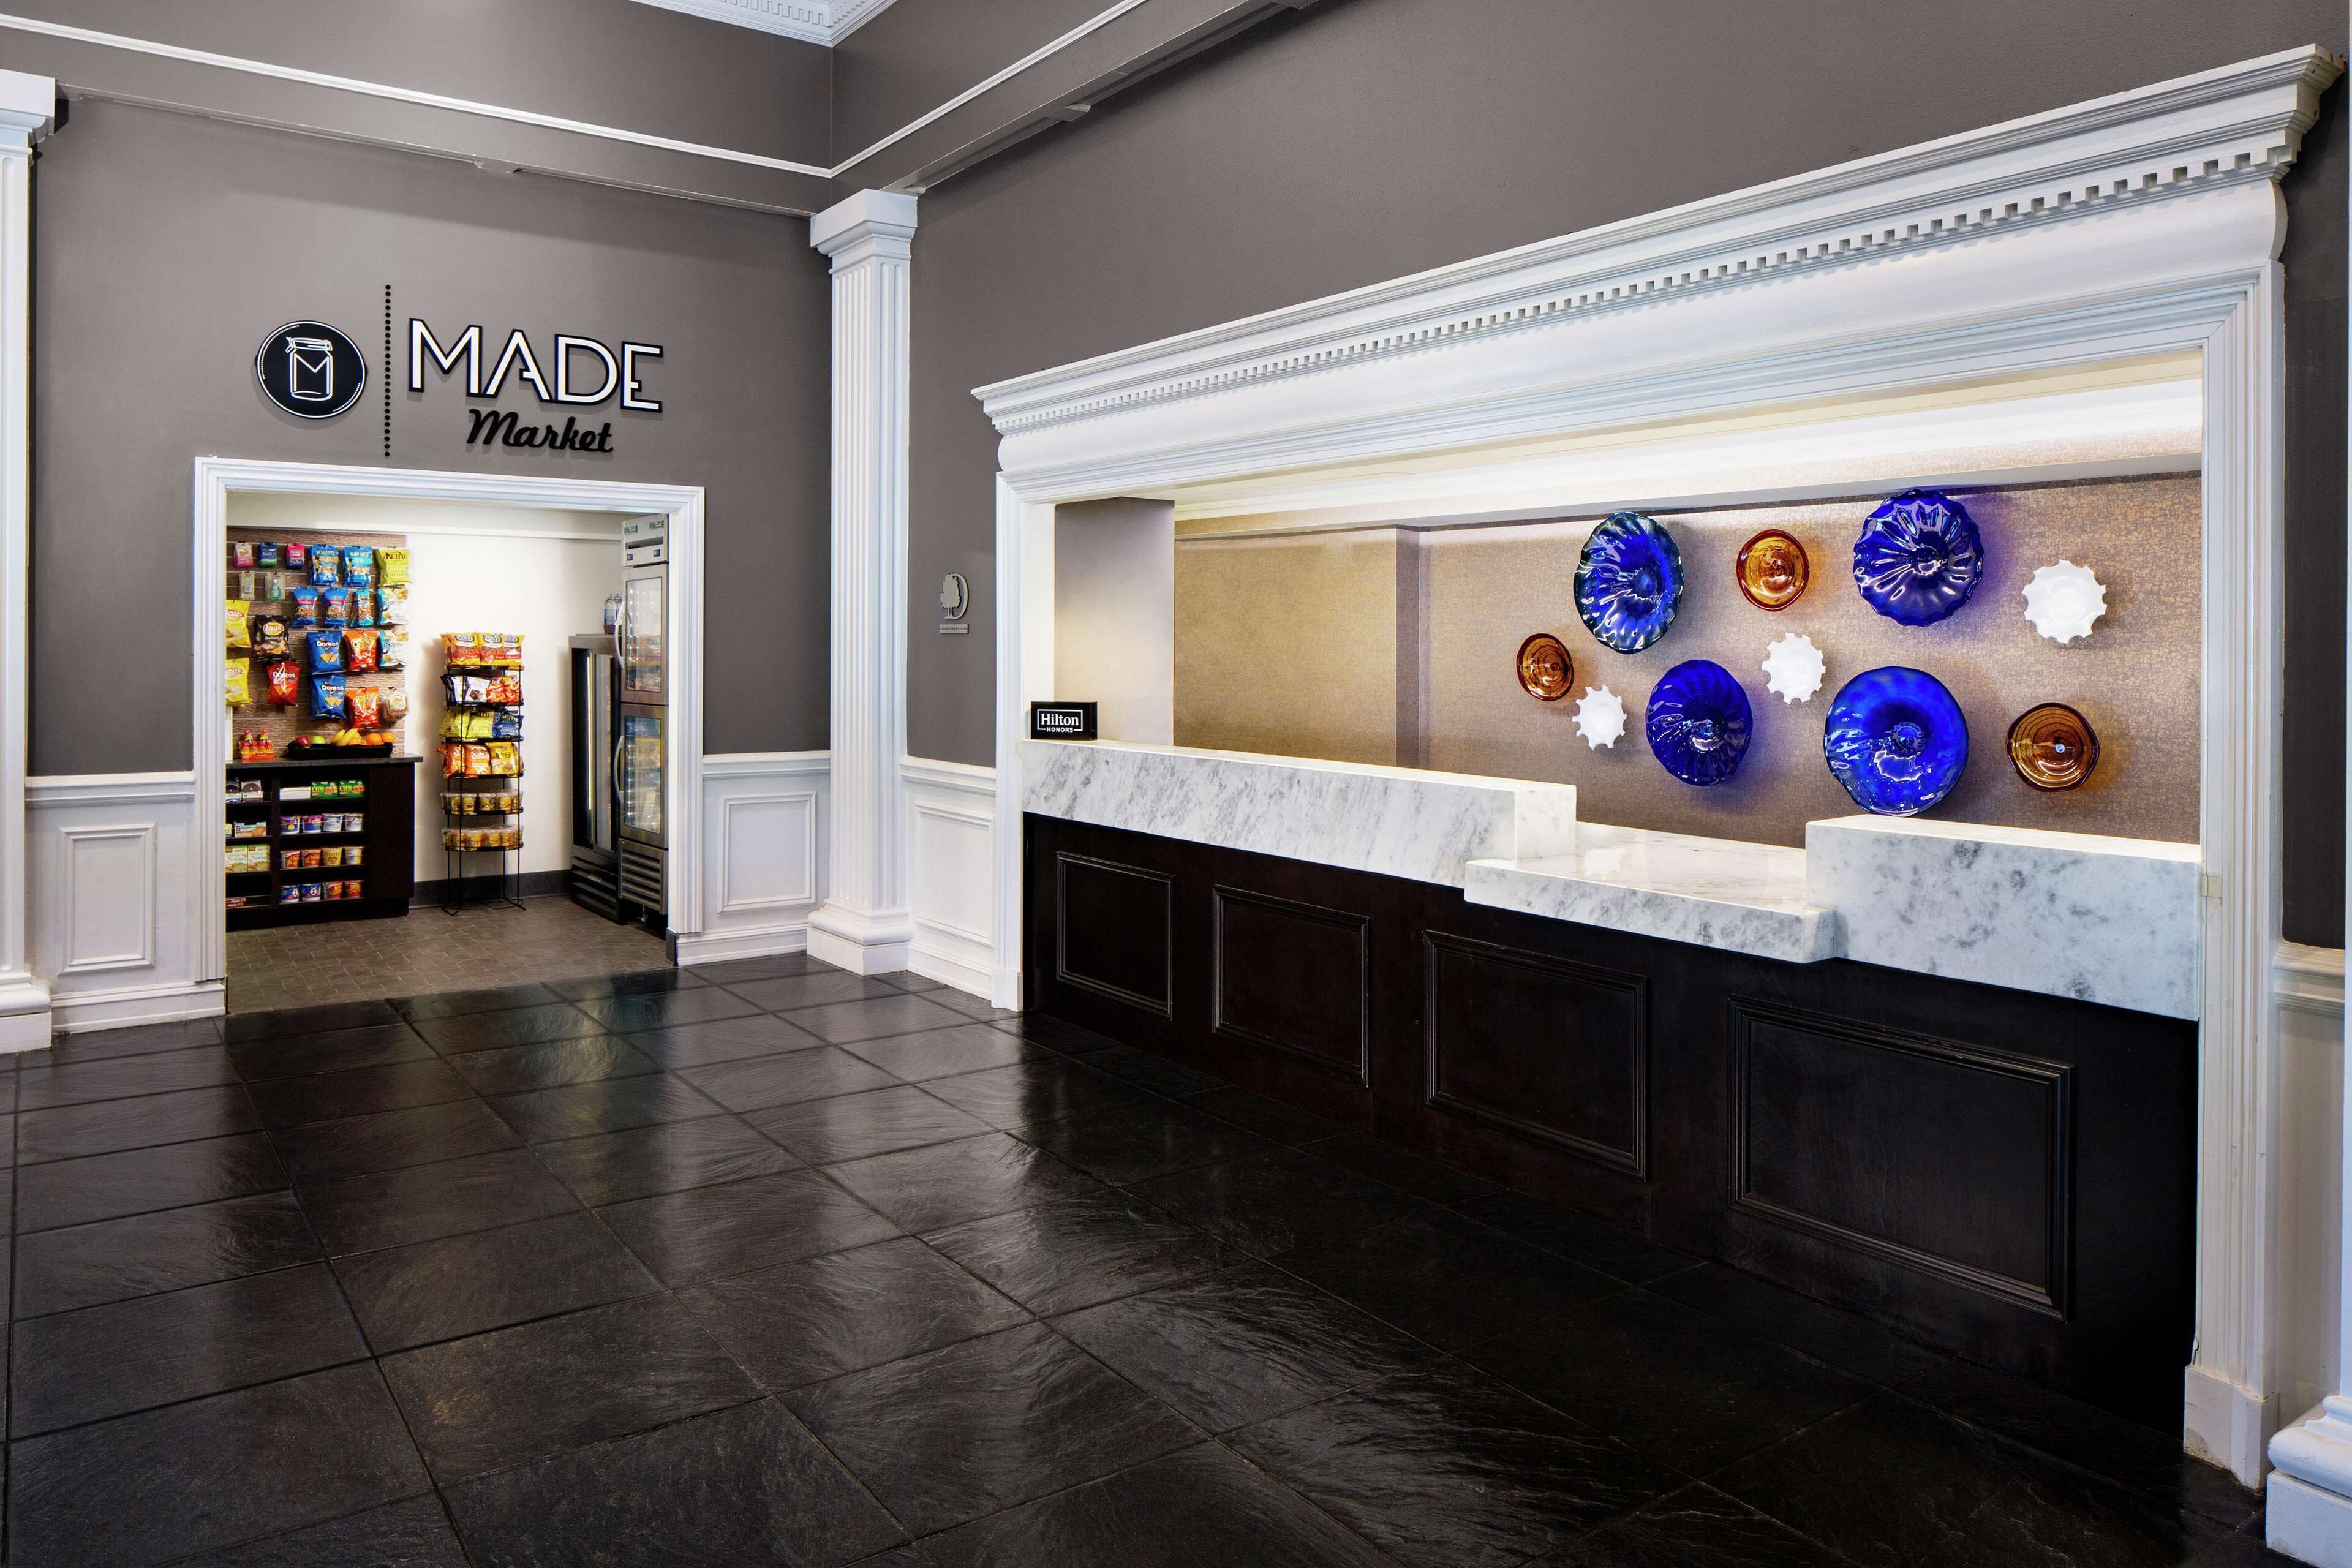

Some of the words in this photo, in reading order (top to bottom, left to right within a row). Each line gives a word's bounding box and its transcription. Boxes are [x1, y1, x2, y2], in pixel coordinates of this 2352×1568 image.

[409, 318, 663, 413] MADE
[466, 409, 614, 453] Market
[1041, 713, 1079, 726] Hilton
